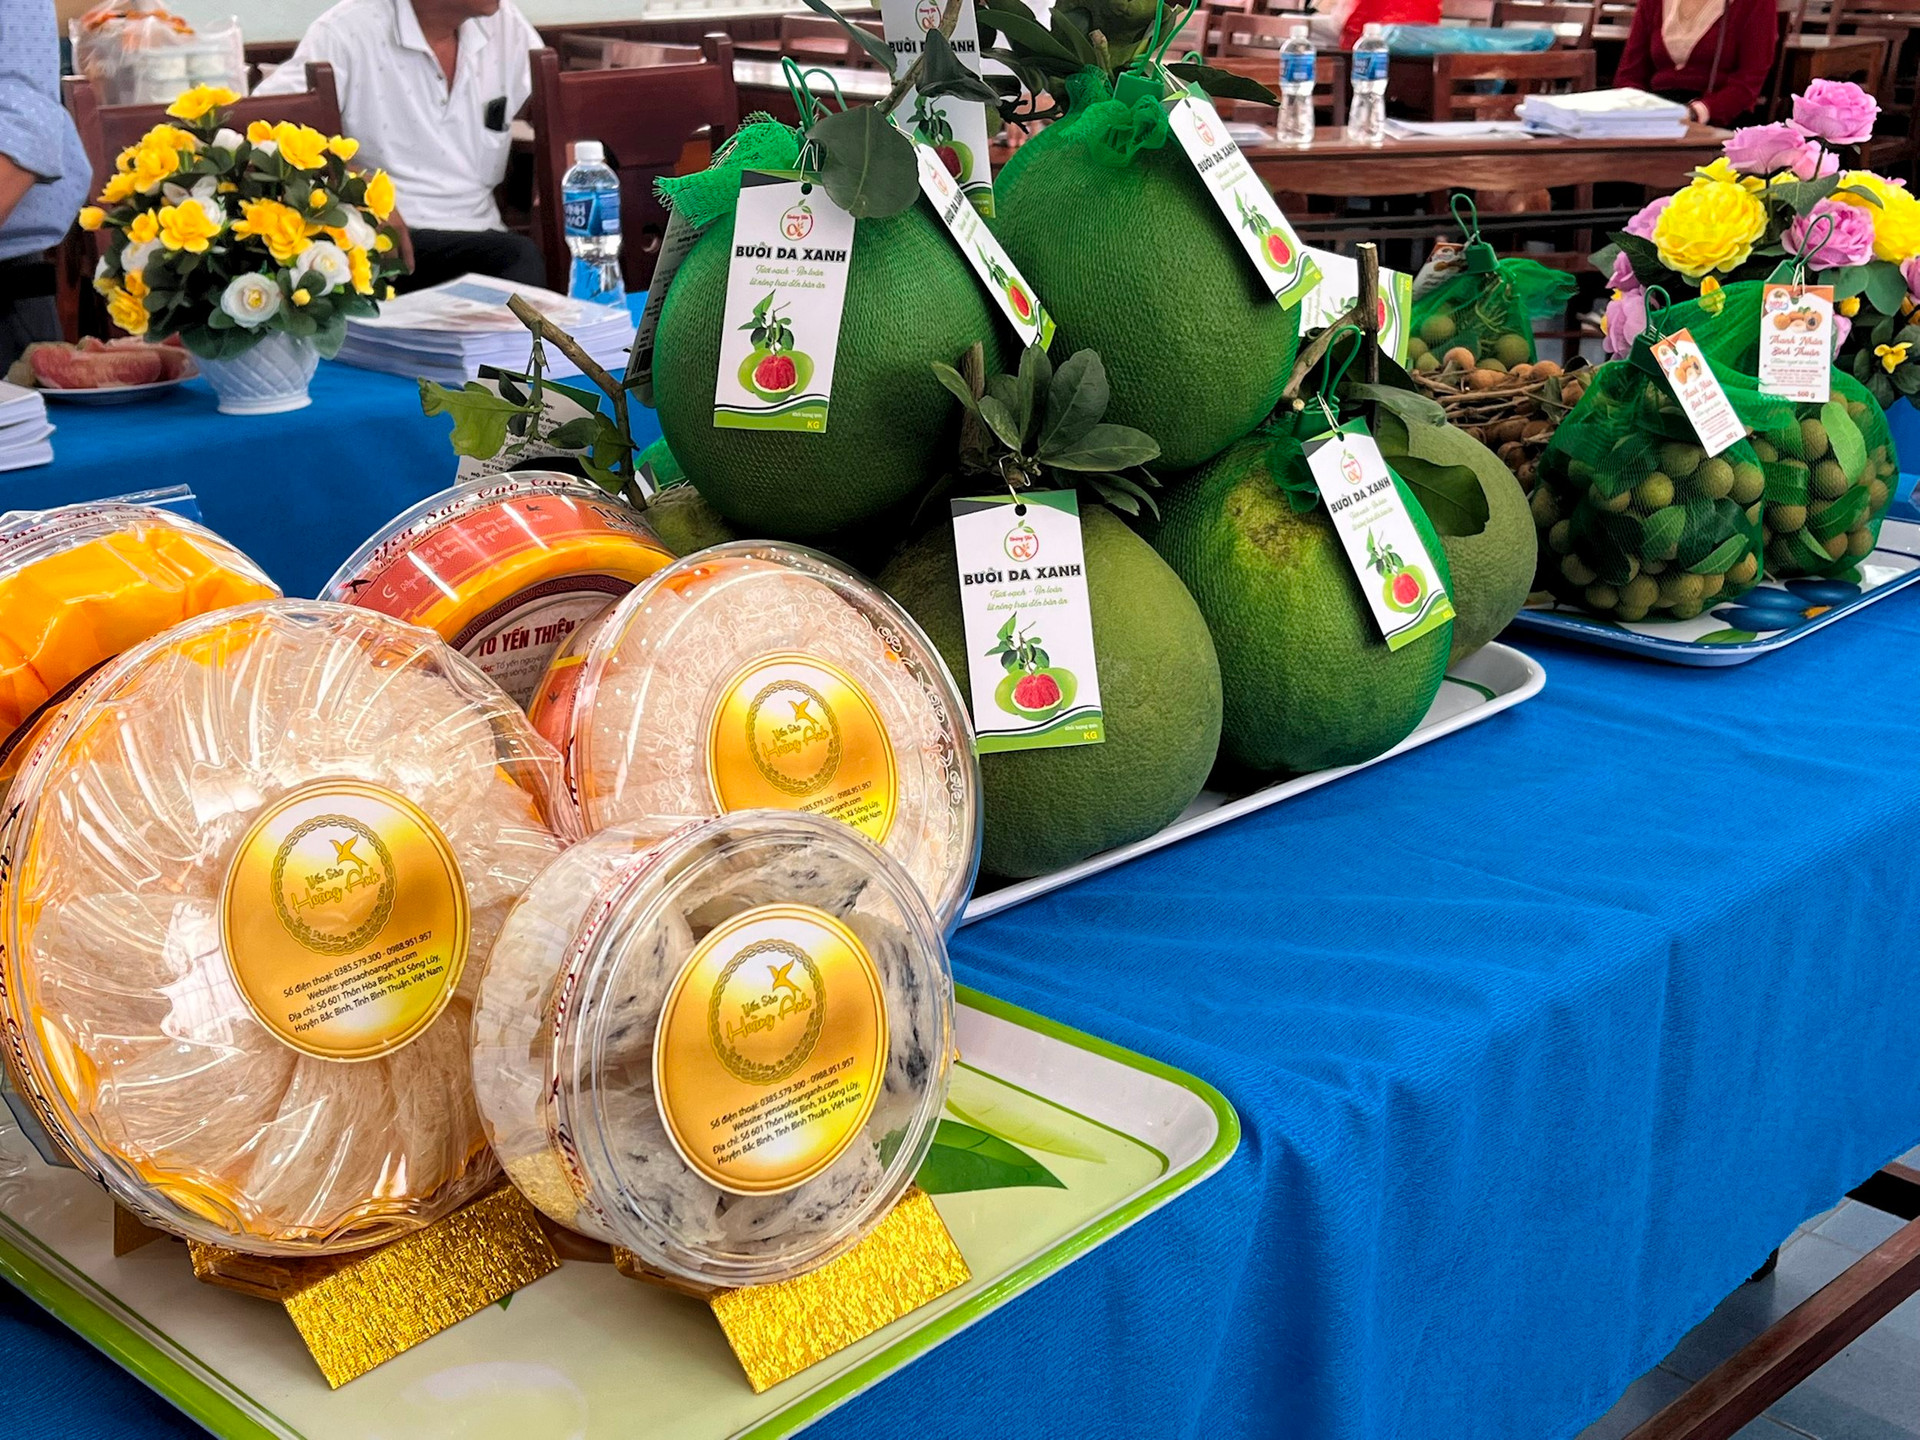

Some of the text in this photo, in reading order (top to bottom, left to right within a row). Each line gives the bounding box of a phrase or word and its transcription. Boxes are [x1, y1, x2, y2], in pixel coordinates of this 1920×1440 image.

[950, 40, 975, 52] ANH
[736, 241, 847, 262] BƯỞI DA XANH
[807, 421, 819, 429] KG
[1352, 489, 1367, 503] DA
[1366, 476, 1391, 496] XANH
[963, 564, 1081, 585] BƯỞI DA XANH
[502, 626, 530, 652] YẾN
[1083, 731, 1098, 740] KG
[870, 810, 883, 818] Nam
[290, 886, 343, 914] Hoàng
[283, 987, 294, 998] Số
[294, 982, 312, 995] điện
[312, 972, 333, 988] thoại:
[334, 951, 381, 977] 0385.579.300
[386, 931, 432, 956] 0988.951.957
[307, 950, 417, 1001] Website: yensaohoanganh.com
[288, 1011, 302, 1023] Địa
[317, 998, 328, 1011] Số
[328, 994, 341, 1006] 601
[343, 987, 361, 1000] Thôn
[362, 981, 377, 994] Hòa
[397, 967, 406, 978] Xã
[407, 960, 426, 973] Sông
[294, 1017, 319, 1033] Huyện
[320, 1010, 333, 1023] Bắc
[370, 989, 387, 1003] Bình
[412, 971, 426, 983] Việt
[427, 964, 444, 977] Nam
[710, 1119, 720, 1130] Số
[721, 1112, 737, 1126] điện
[738, 1103, 759, 1118] thoại:
[760, 1079, 806, 1107] 0385.579.300
[810, 1056, 855, 1084] 0988.951.957
[732, 1078, 839, 1132] Website: yensaohoanganh.com
[712, 1144, 726, 1155] Địa
[740, 1130, 751, 1143] Số
[751, 1125, 764, 1136] 601
[765, 1117, 784, 1131] Thôn
[784, 1110, 799, 1123] Hòa
[828, 1087, 846, 1102] Sông
[717, 1149, 742, 1165] Huyện
[742, 1142, 756, 1154] Bắc
[791, 1117, 808, 1131] Bình
[830, 1099, 845, 1113] Việt
[845, 1092, 862, 1104] Nam
